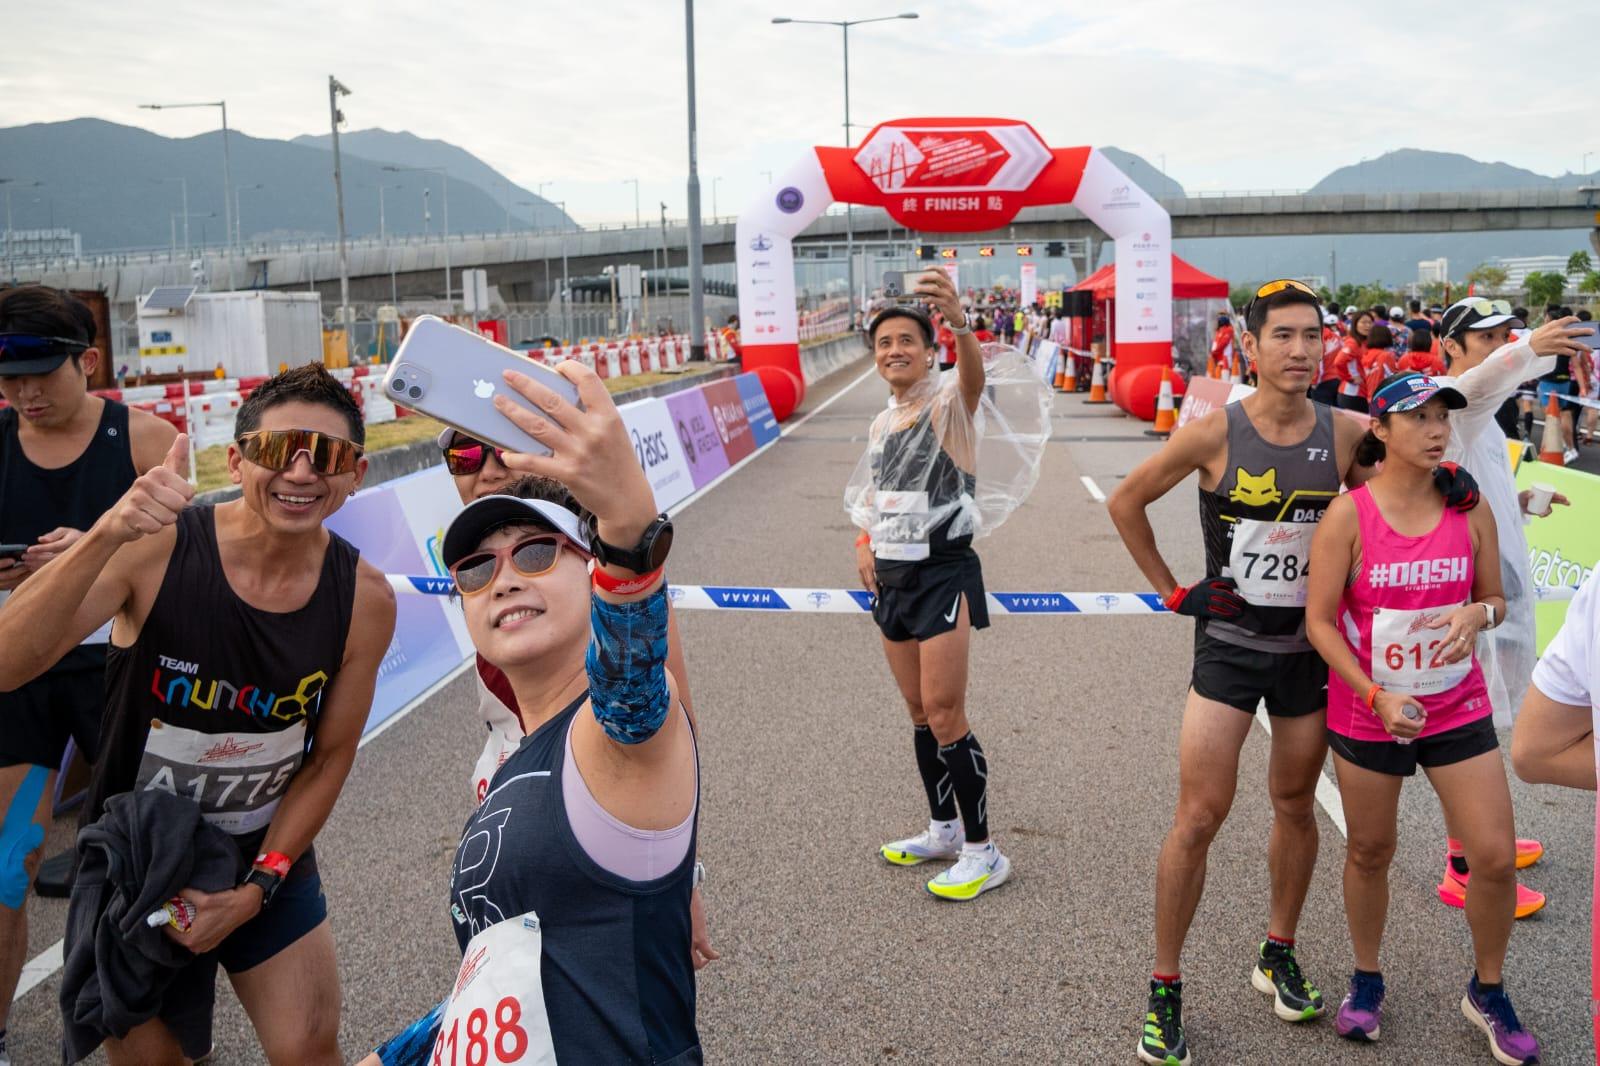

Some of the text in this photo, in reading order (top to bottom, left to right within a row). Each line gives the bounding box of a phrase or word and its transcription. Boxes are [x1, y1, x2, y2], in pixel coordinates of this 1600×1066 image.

[902, 196, 1003, 212] 終 FINISH 點
[1369, 556, 1468, 588] #DASH
[722, 592, 770, 604] HKAAA
[1012, 597, 1060, 607] HKAAA
[159, 655, 199, 675] TEAM
[143, 762, 294, 808] A1775
[434, 996, 528, 1066] 8188
